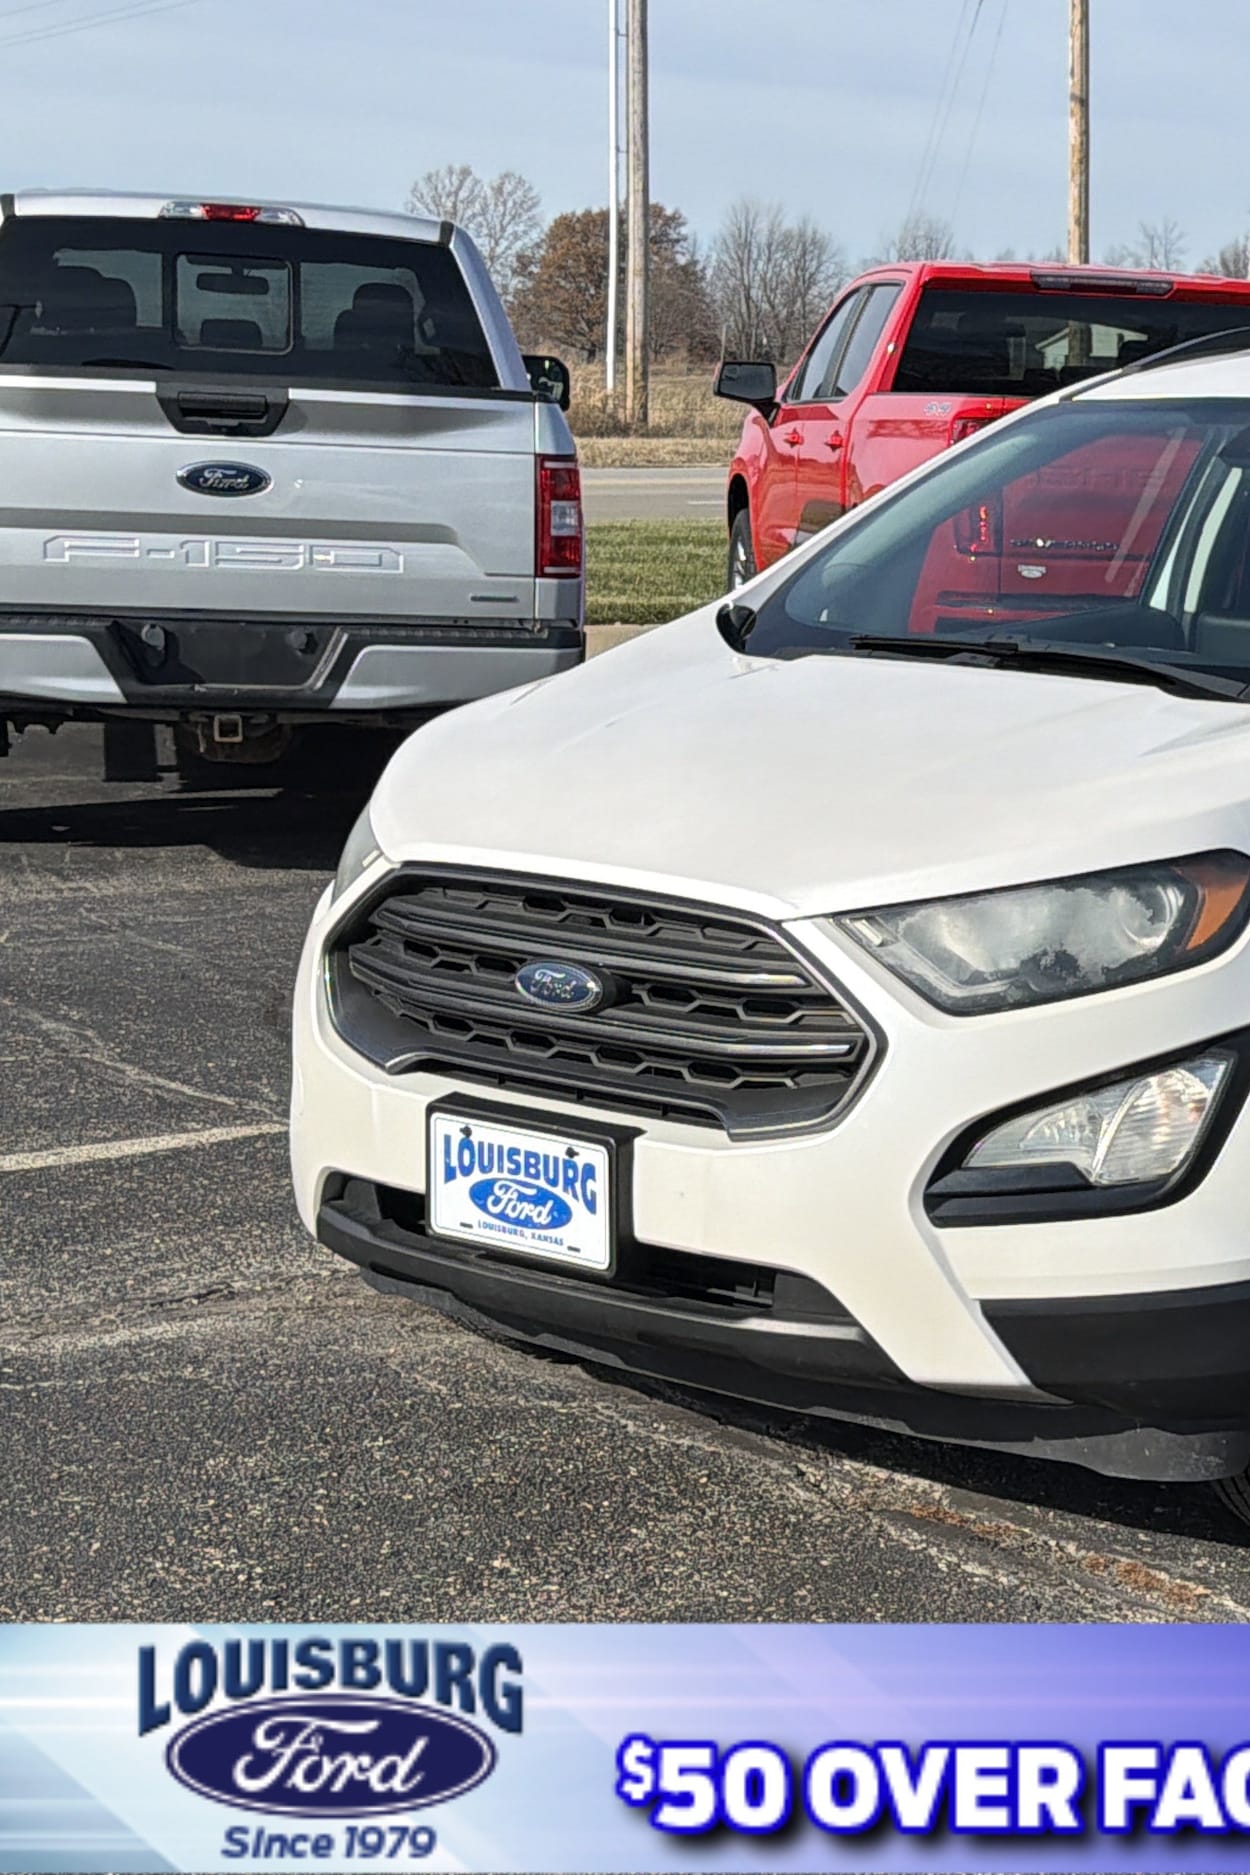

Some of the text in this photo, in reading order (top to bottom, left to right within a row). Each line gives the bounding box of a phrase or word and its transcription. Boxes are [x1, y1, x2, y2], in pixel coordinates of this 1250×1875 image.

[42, 534, 404, 574] F-150
[530, 968, 577, 999] Ford
[443, 1134, 598, 1215] LOUISBURG
[486, 1180, 554, 1225] Ford
[477, 1219, 564, 1247] LOUISBURG, KANSAS
